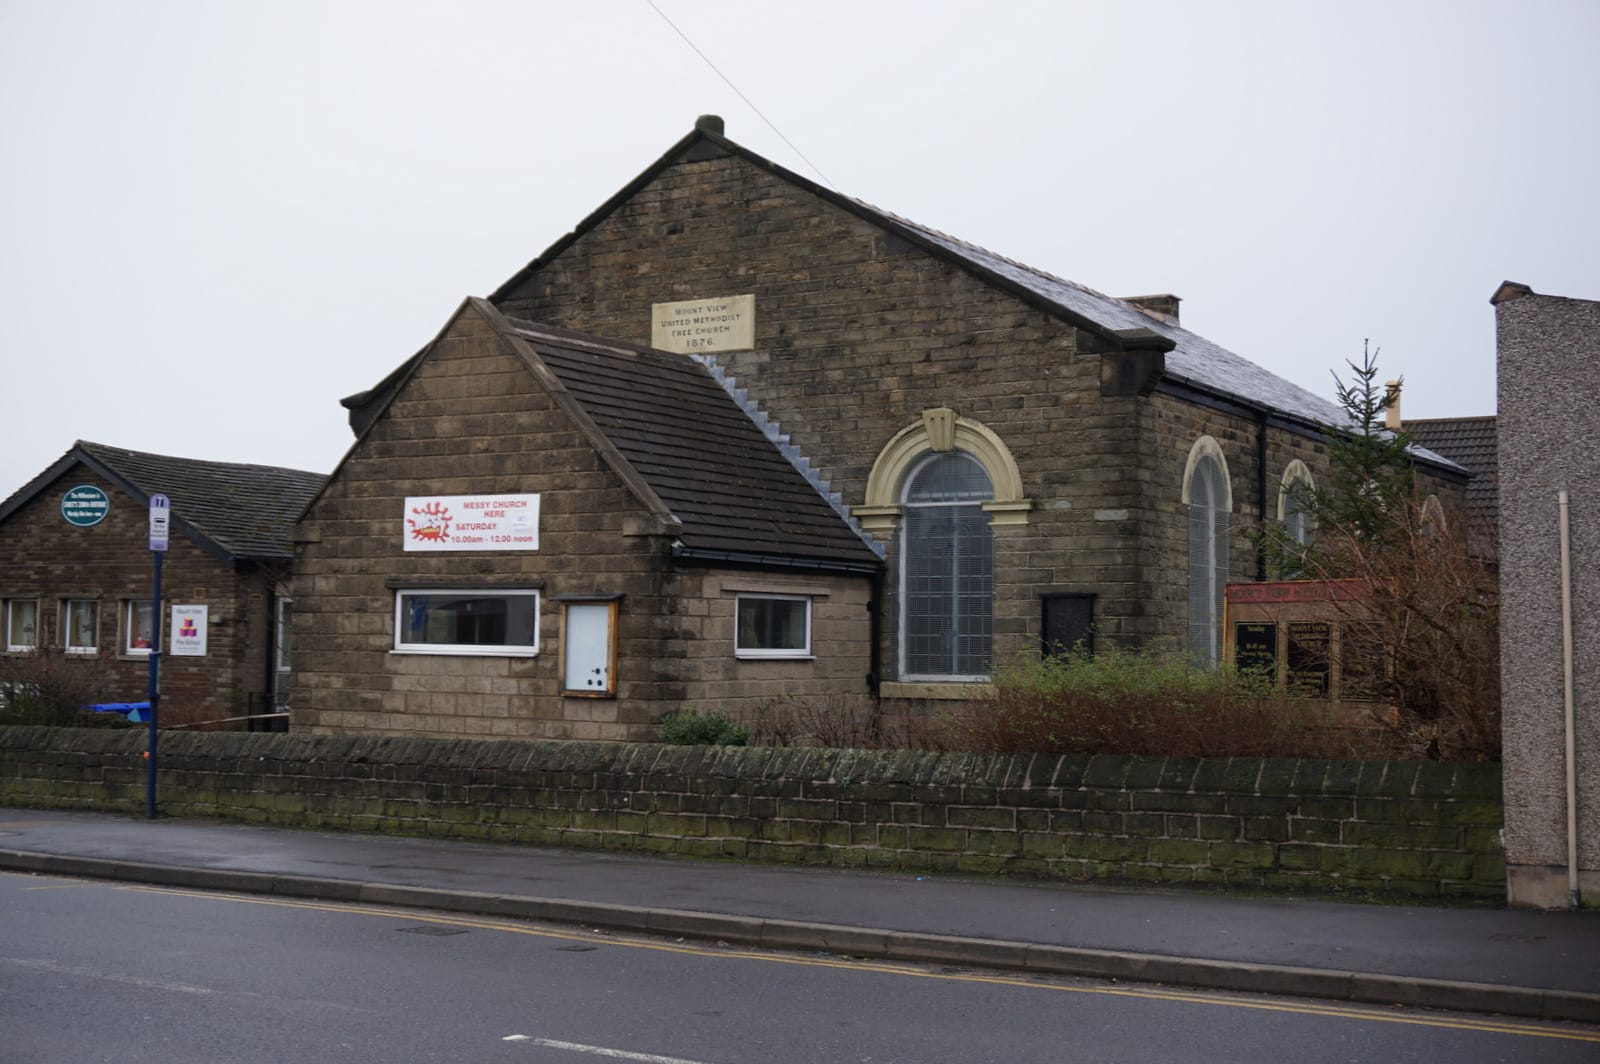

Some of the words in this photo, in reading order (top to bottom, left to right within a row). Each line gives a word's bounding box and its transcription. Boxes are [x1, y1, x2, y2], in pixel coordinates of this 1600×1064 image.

[674, 307, 702, 316] MOUNT
[706, 305, 728, 313] VIEW
[661, 319, 691, 328] UNITED
[693, 314, 741, 324] METHODIST
[672, 329, 692, 337] FREE
[695, 325, 730, 334] CHURCH
[686, 338, 713, 347] 1876
[463, 501, 490, 509] MESSY
[492, 500, 527, 509] CHURCH
[484, 510, 505, 518] HERE
[455, 522, 497, 531] SATURDAY
[451, 535, 483, 544] 10.00am
[490, 535, 511, 543] 12.00
